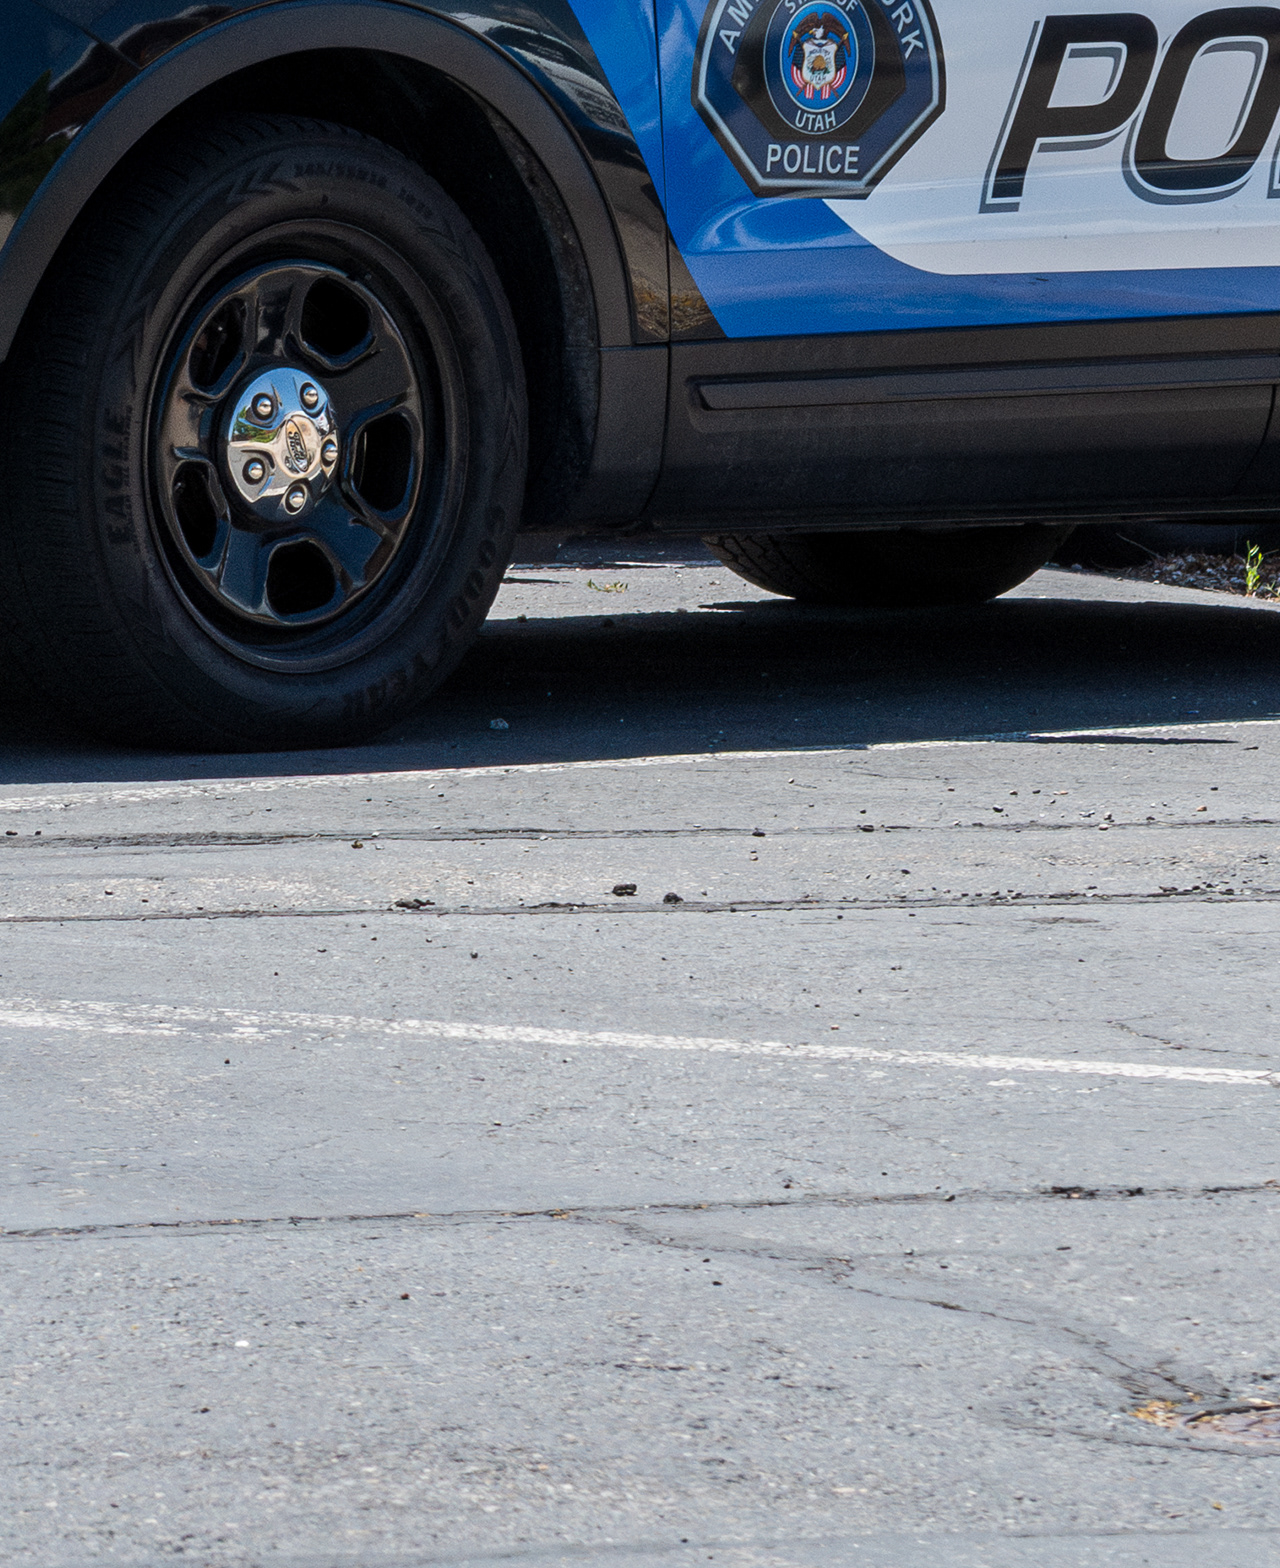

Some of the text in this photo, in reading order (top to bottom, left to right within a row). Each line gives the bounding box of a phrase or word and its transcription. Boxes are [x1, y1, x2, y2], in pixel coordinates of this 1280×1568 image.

[794, 110, 837, 132] UTAH
[766, 143, 860, 175] POLICE
[102, 407, 132, 545] EAGLE
